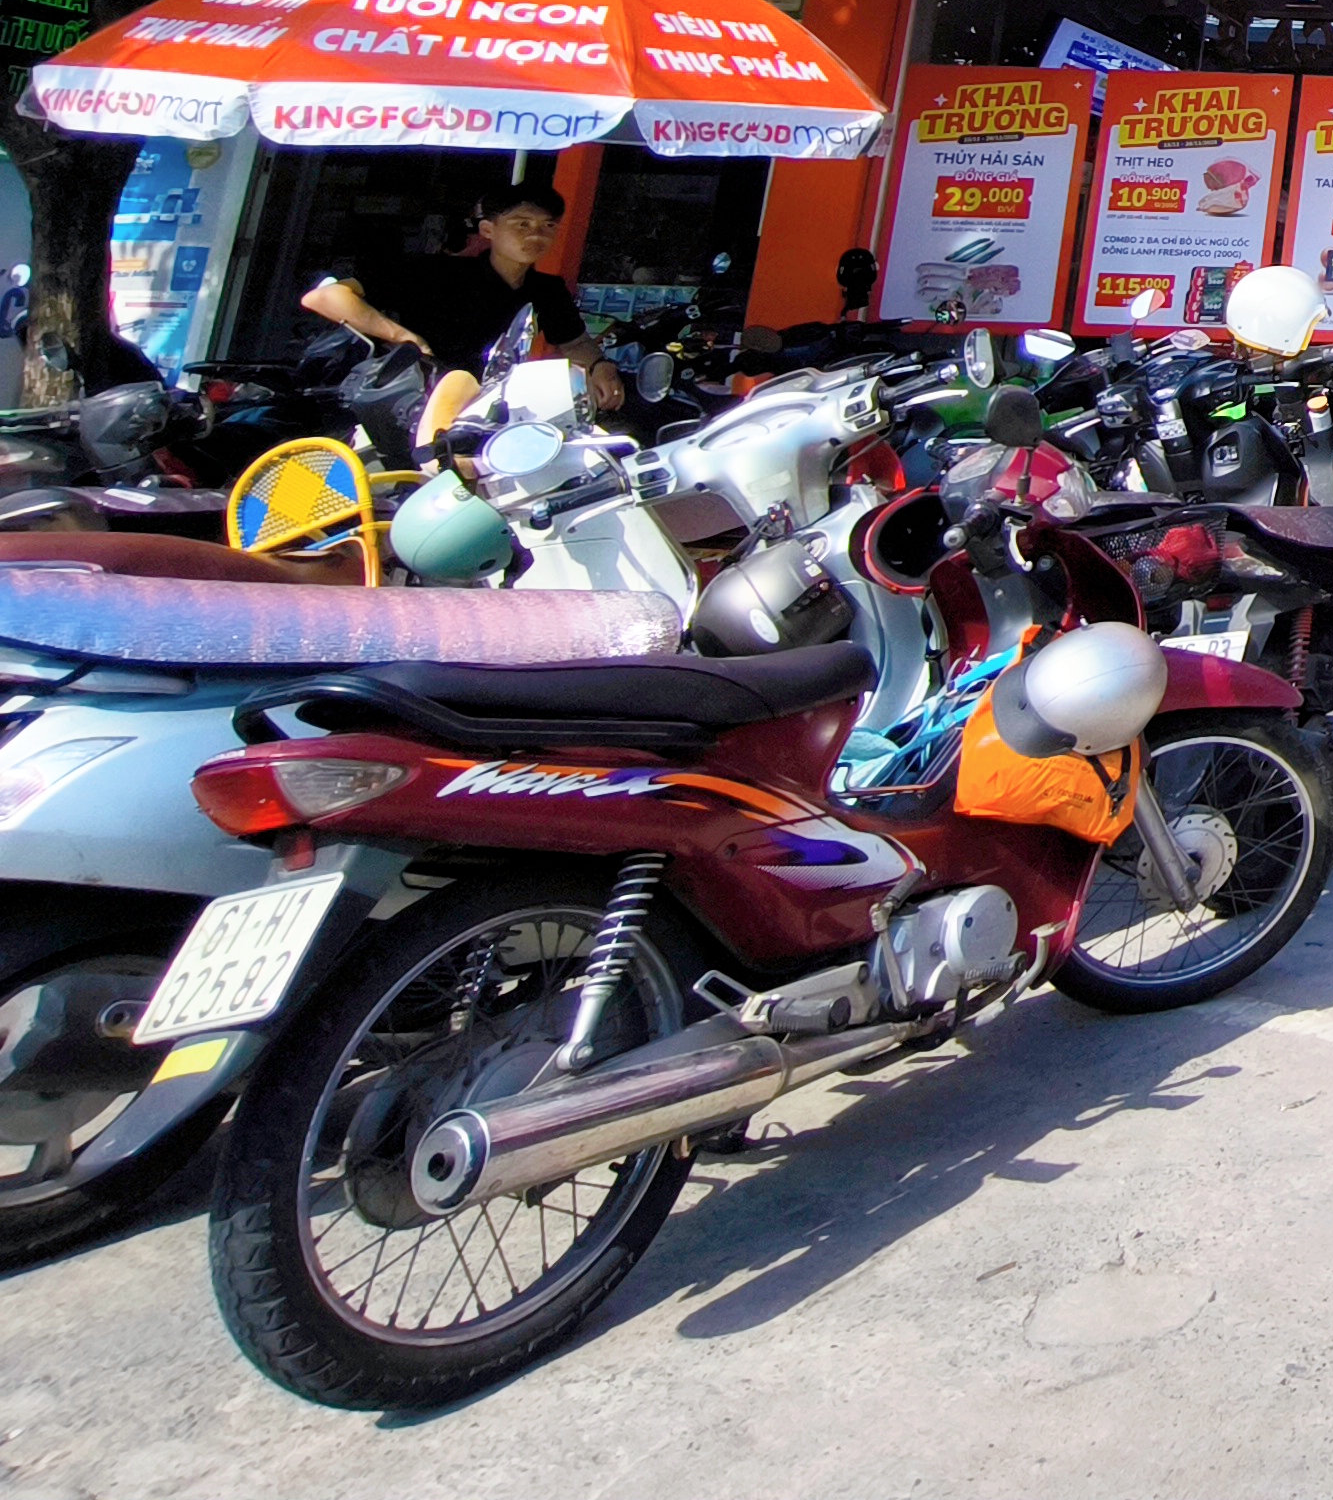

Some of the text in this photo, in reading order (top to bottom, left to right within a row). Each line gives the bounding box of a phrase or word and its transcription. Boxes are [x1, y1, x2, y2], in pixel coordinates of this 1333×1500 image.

[469, 0, 609, 27] NGON
[654, 11, 779, 47] SIÊU THỊ
[313, 25, 610, 67] CHẤT LƯỢNG
[645, 47, 829, 83] THỰC PHẨM
[957, 84, 1039, 109] KHAI
[1157, 89, 1236, 114] KHAI
[923, 106, 1066, 135] TRƯƠNG
[1124, 111, 1264, 140] TRƯƠNG
[934, 150, 1045, 166] THỦY HẢI SẢN
[1115, 156, 1174, 170] THỊT HEO
[943, 187, 1025, 212] 29.000
[1117, 186, 1181, 207] 10.900
[1103, 234, 1138, 245] COMBO
[1101, 276, 1170, 296] 115.000
[201, 888, 314, 959] 61-H1
[152, 951, 291, 1029] 325.82
